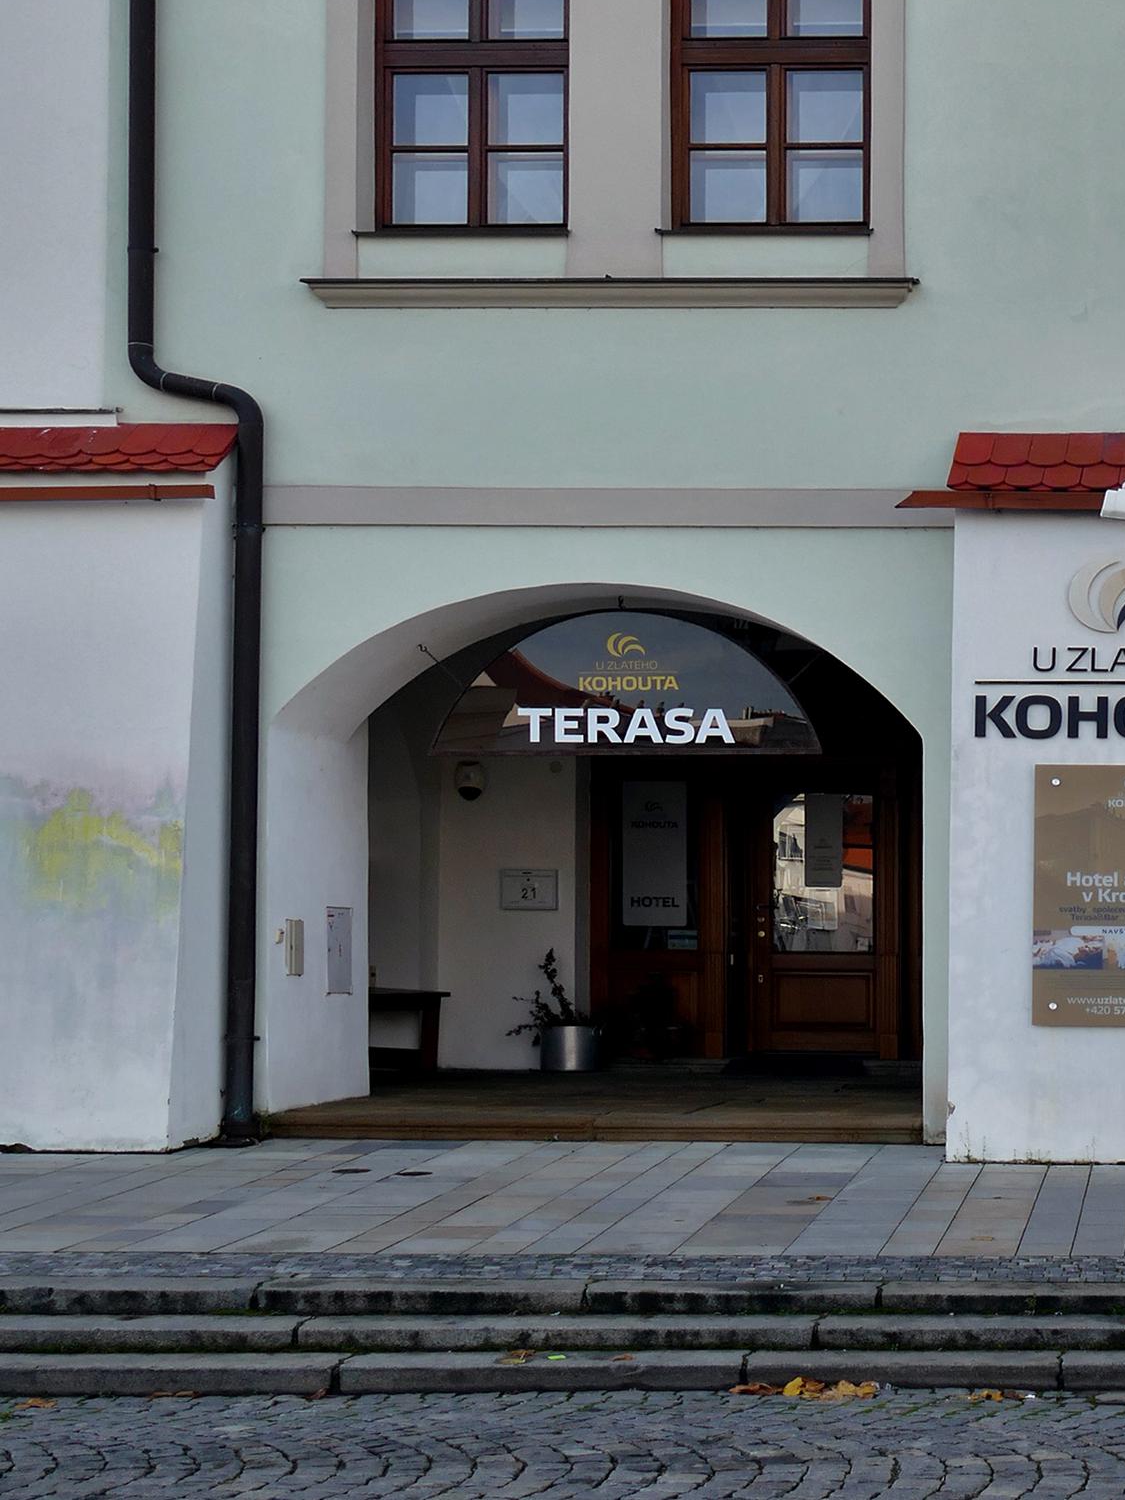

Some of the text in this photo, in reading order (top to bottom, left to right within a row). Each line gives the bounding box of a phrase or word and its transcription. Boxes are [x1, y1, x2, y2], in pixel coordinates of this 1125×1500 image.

[1032, 646, 1056, 672] U
[578, 675, 679, 692] KOHOUTA
[517, 707, 736, 744] TERASA
[1066, 872, 1119, 888] Hotel
[521, 887, 537, 900] 21
[1082, 891, 1093, 902] v
[630, 896, 680, 909] HOTEL
[1085, 1006, 1111, 1015] +420
